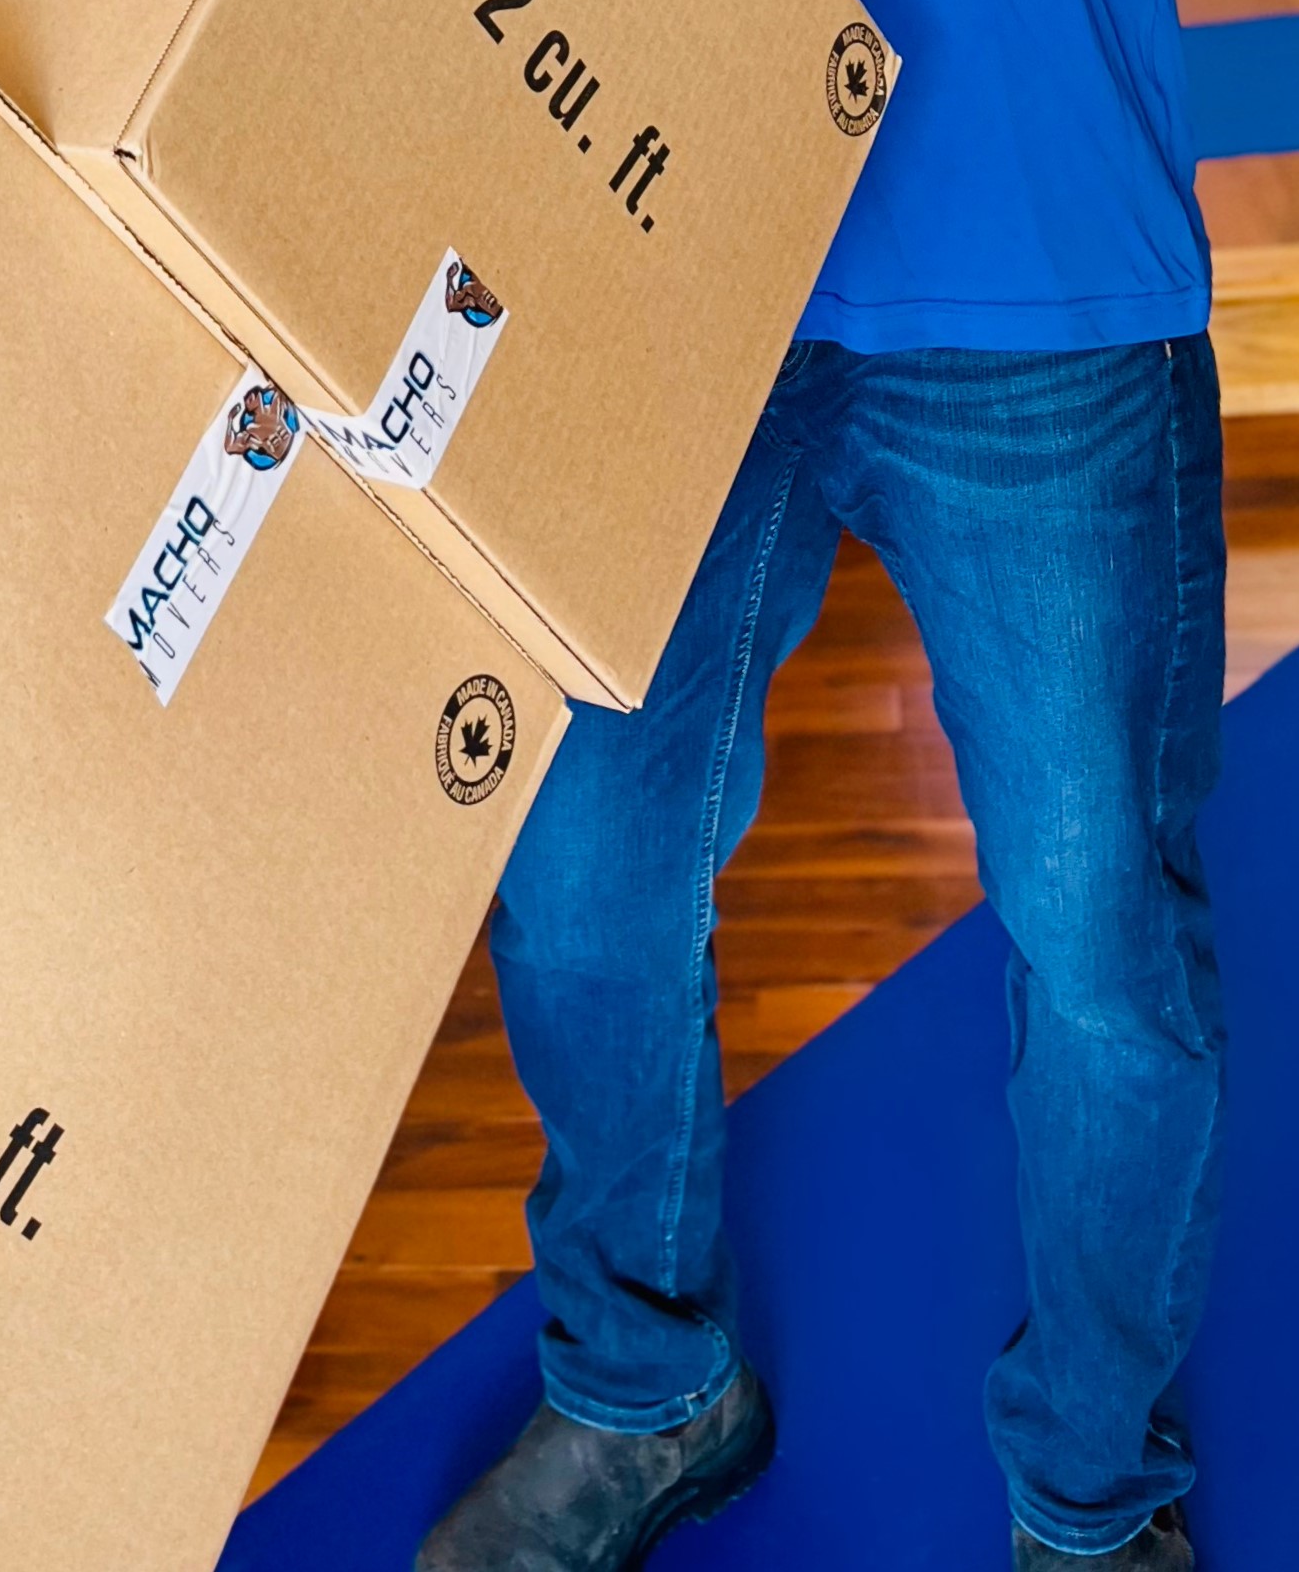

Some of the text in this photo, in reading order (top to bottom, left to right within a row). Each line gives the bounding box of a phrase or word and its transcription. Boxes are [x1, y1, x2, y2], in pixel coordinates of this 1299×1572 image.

[841, 25, 865, 47] MADE
[523, 29, 601, 154] cu.
[608, 125, 671, 234] ft.
[317, 350, 435, 450] MACHO
[126, 494, 215, 651] MACHO
[455, 678, 515, 752] MADE IN CANADA
[449, 781, 467, 802] AU
[464, 765, 505, 804] CANADA
